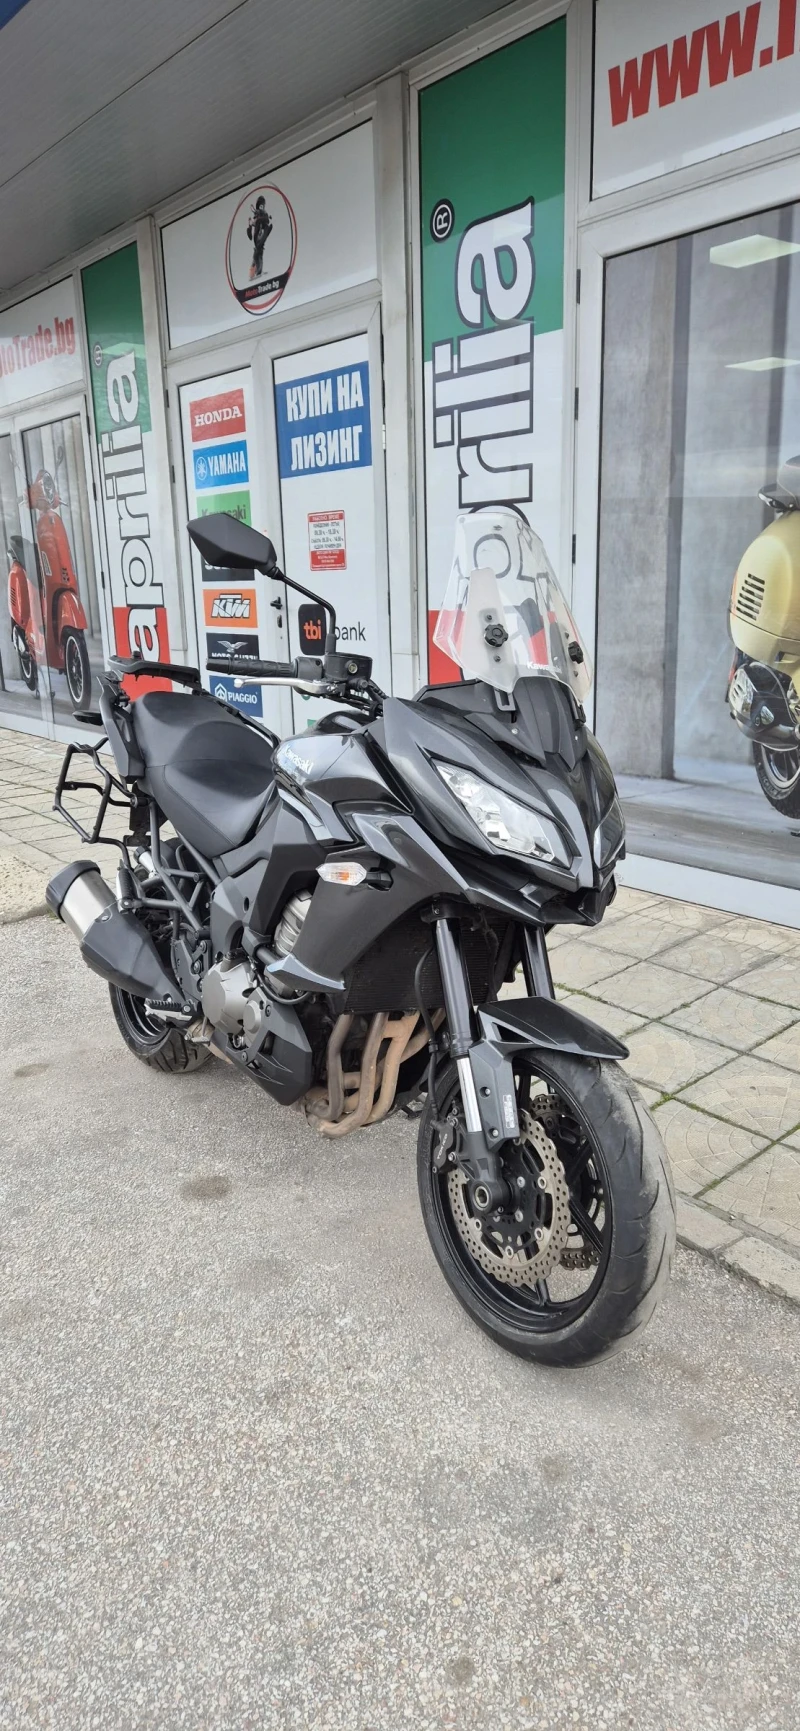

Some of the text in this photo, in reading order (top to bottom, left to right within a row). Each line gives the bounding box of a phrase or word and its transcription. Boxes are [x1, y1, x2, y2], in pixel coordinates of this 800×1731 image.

[286, 370, 364, 422] КУПИ НА
[194, 405, 243, 427] HONDA
[291, 424, 363, 471] ЛИЗИНГ
[207, 450, 247, 477] YAMAHA
[211, 594, 251, 618] KTM
[303, 619, 322, 640] tbi
[227, 691, 257, 704] PIAGGIO
[284, 745, 314, 775] Kawasaki
